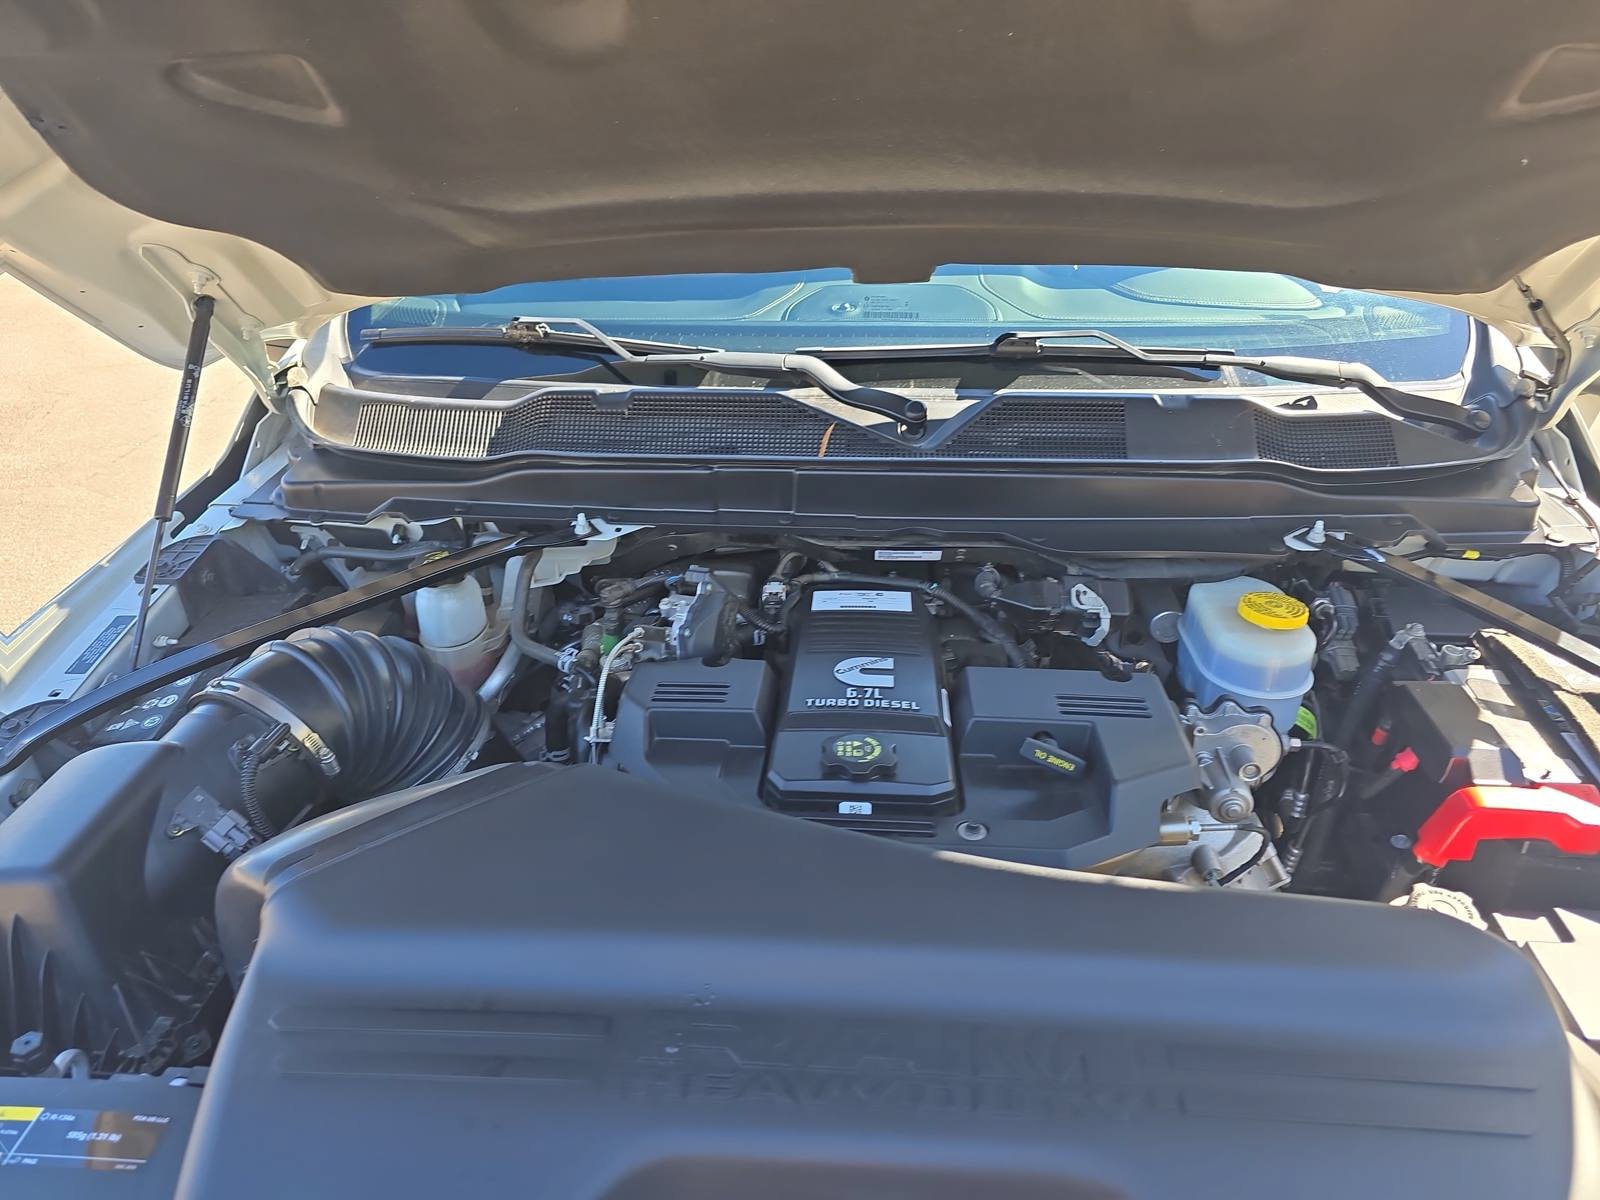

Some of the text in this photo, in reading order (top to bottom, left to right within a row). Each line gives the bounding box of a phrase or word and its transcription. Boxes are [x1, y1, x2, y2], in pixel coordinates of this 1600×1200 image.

[834, 658, 888, 675] Cummins
[846, 687, 883, 699] 6.7L
[805, 698, 921, 710] TURBO DIESEL
